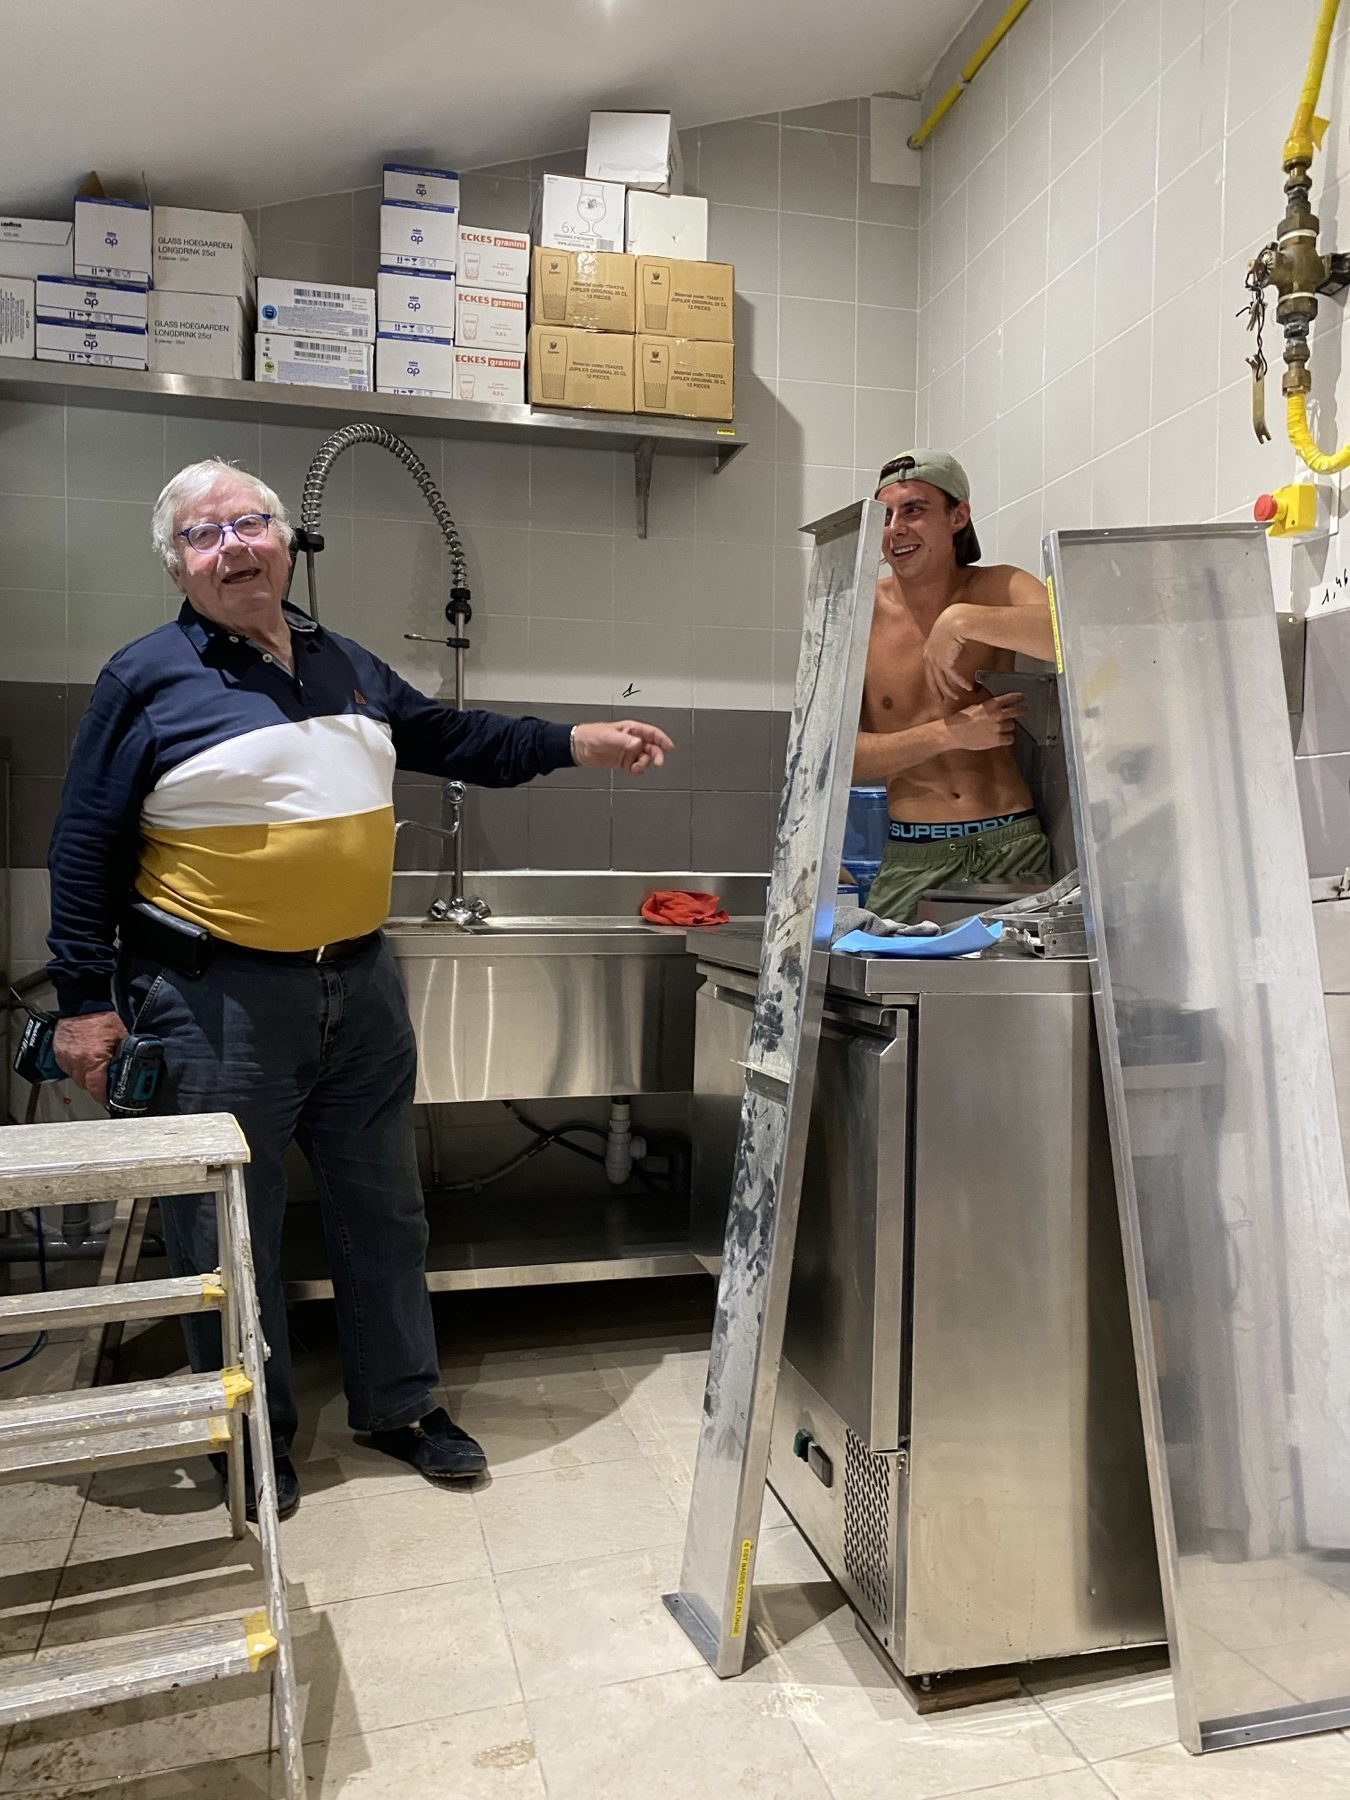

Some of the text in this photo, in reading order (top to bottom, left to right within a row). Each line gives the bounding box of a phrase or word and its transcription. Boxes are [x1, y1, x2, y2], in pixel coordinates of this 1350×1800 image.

[561, 221, 576, 234] 6x
[158, 237, 233, 249] GLASS HOEGAARDEN
[461, 233, 525, 248] ECKES granini
[158, 246, 200, 256] LONGDRINK
[458, 293, 522, 309] ECKES granini
[154, 320, 230, 332] GLASS HOEGAARDEN
[154, 329, 197, 339] LONGDRINK
[455, 354, 519, 368] ECKES granini
[891, 816, 1014, 838] SUPERDRY
